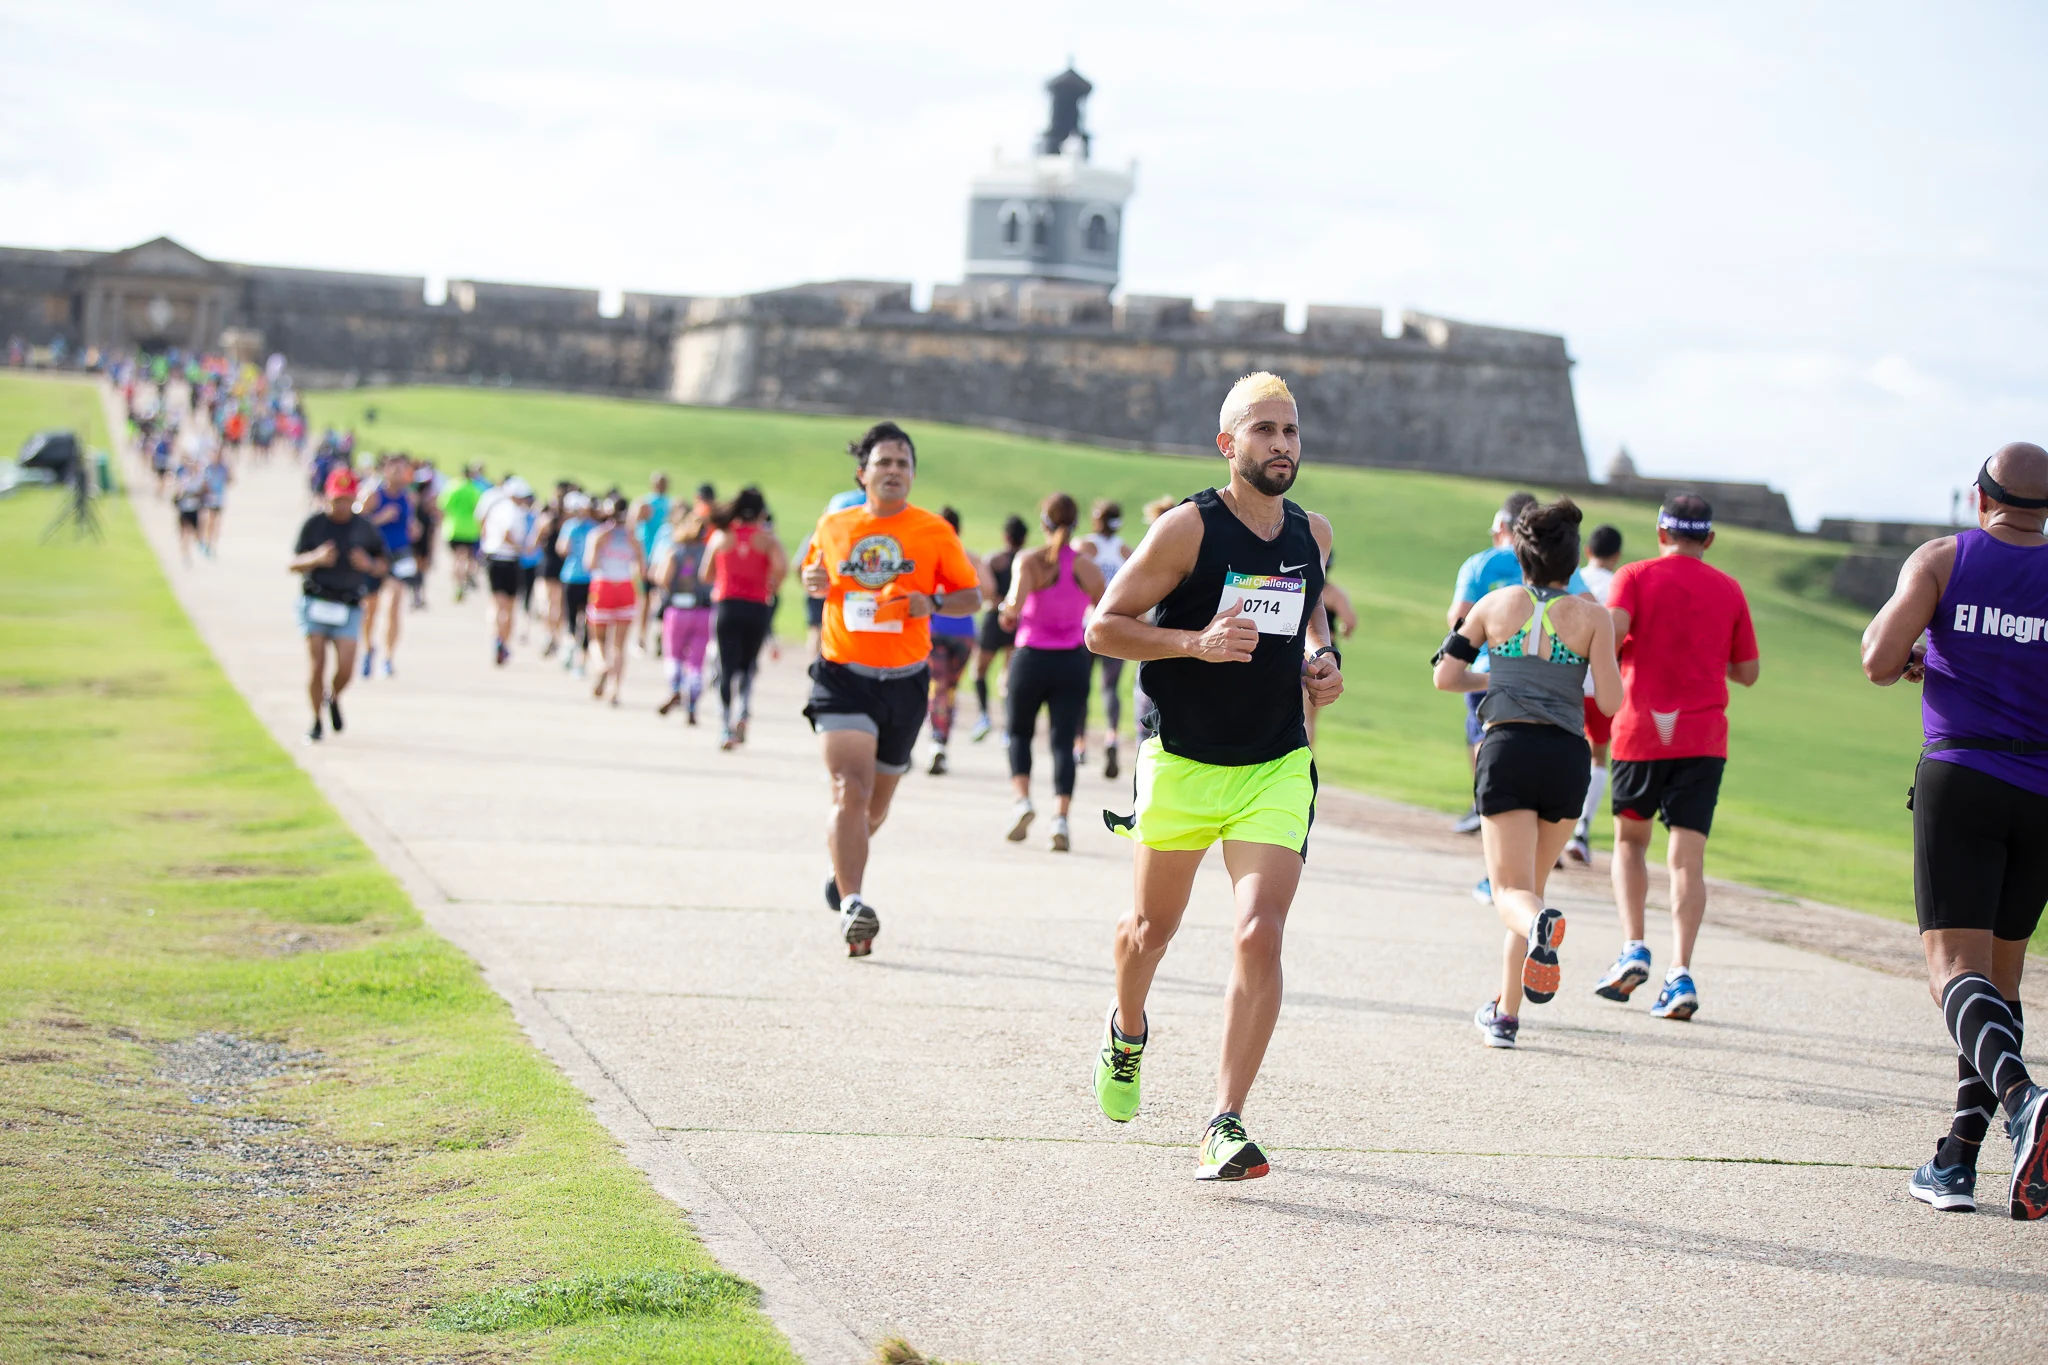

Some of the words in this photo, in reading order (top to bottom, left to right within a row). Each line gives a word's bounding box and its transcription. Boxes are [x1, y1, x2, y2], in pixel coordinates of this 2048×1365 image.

[1232, 575, 1252, 586] Full
[1253, 577, 1299, 591] Challenge
[1243, 599, 1281, 614] 0714
[1953, 604, 1978, 633] El
